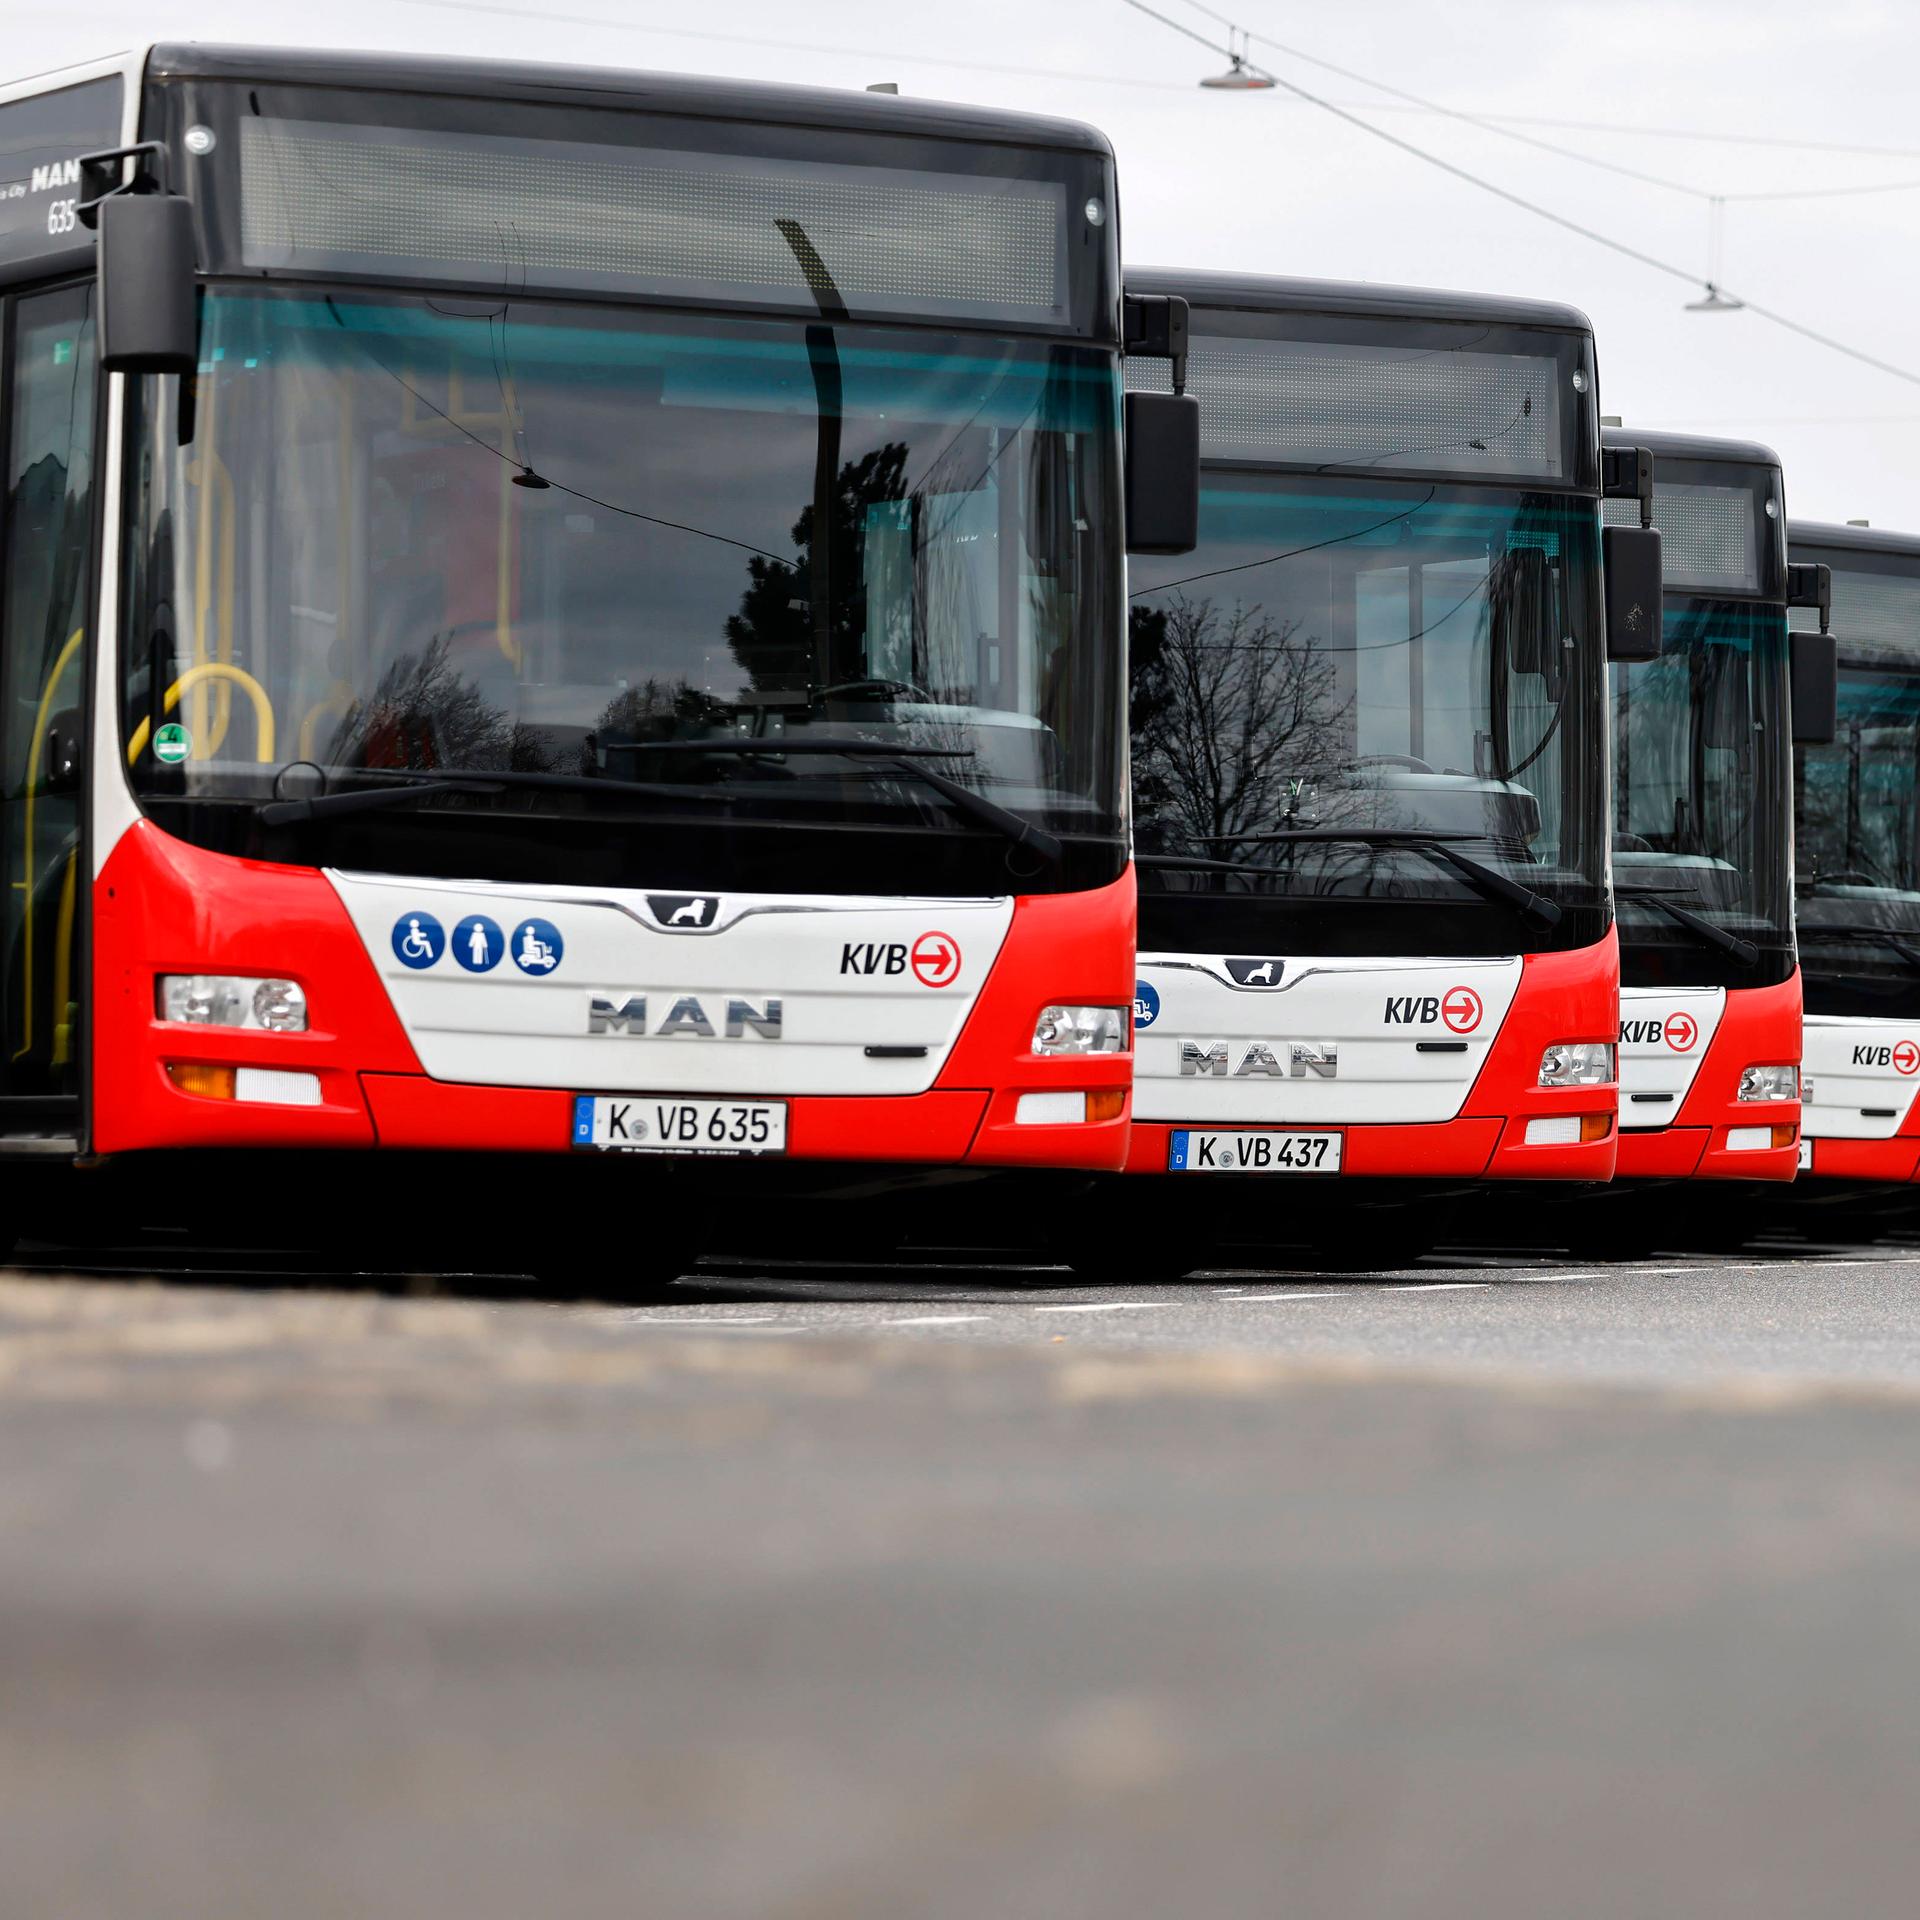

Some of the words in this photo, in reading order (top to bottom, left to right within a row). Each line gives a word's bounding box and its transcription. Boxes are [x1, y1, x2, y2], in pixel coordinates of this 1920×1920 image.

[31, 158, 80, 192] MAN
[48, 199, 76, 234] 635
[167, 726, 178, 743] 4
[840, 943, 907, 975] KVB
[587, 991, 783, 1039] MAN
[1384, 997, 1440, 1024] KVB
[1618, 1020, 1663, 1043] KVB
[1179, 1039, 1338, 1078] MAN
[1852, 1045, 1891, 1066] KVB
[579, 1124, 589, 1136] D
[609, 1103, 631, 1139] K
[657, 1105, 698, 1141] VB
[708, 1107, 770, 1143] 635
[1176, 1154, 1183, 1164] D
[1198, 1136, 1217, 1167] K
[1237, 1137, 1271, 1168] VB
[1277, 1138, 1329, 1168] 437
